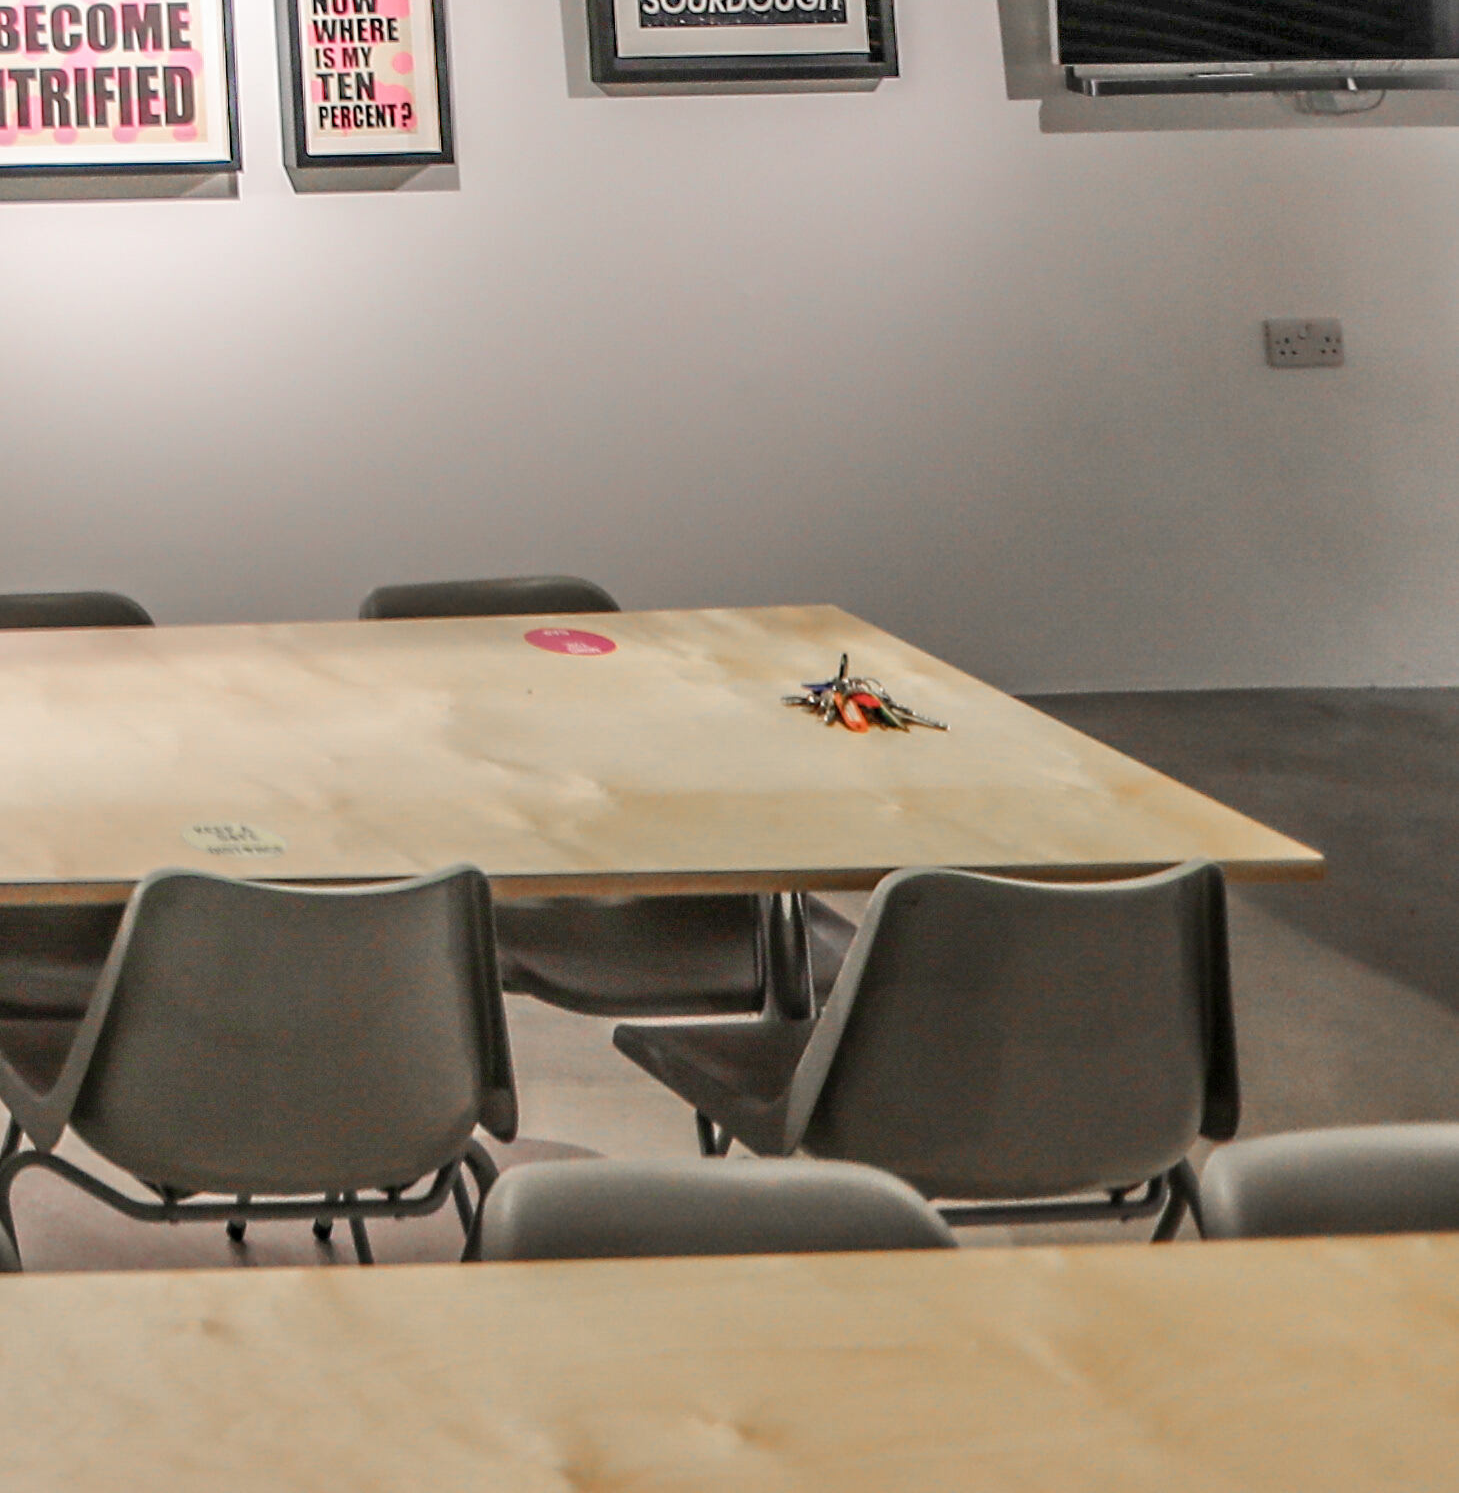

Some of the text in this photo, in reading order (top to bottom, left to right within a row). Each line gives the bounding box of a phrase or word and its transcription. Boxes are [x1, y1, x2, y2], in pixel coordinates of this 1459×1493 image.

[314, 17, 400, 44] WHERE
[315, 46, 373, 69] IS MY
[316, 71, 376, 102] TEN
